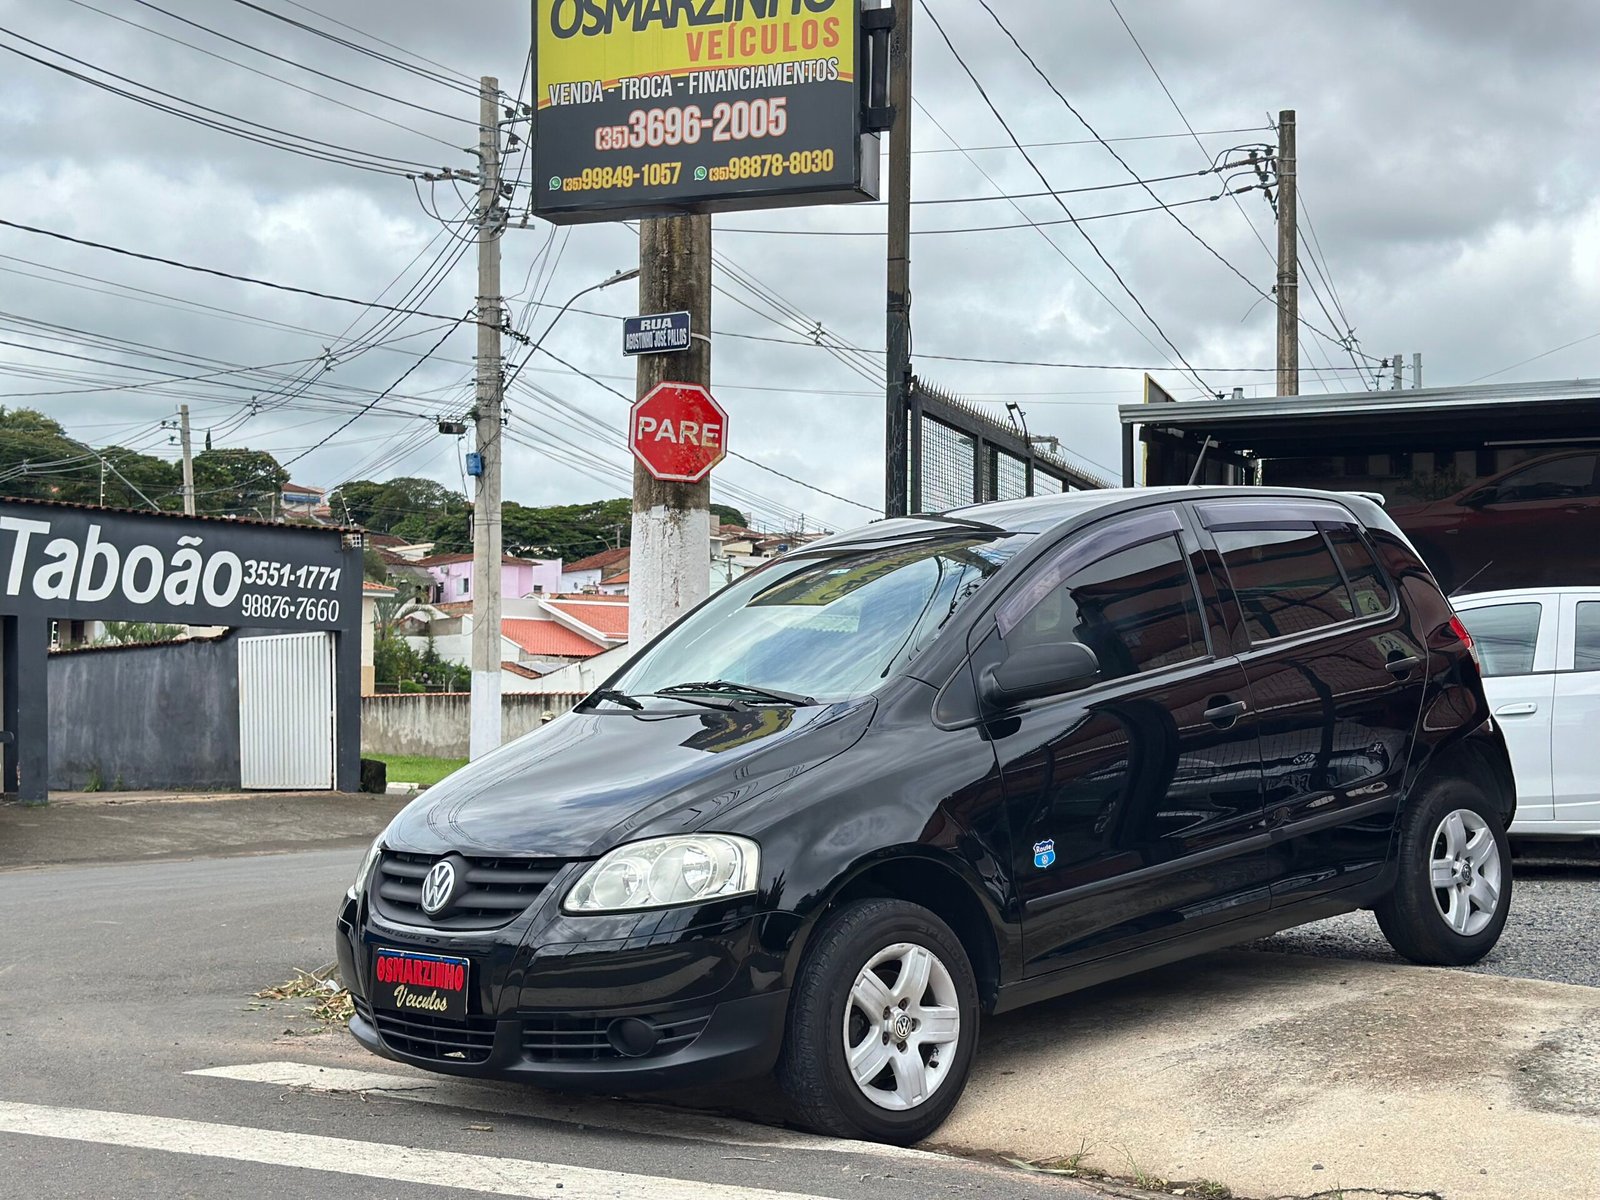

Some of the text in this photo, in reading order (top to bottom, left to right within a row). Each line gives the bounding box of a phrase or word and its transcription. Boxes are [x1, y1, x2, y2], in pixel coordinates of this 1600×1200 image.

[550, 0, 836, 39] OSMARZ
[685, 16, 841, 62] VEÍCULOS
[548, 80, 604, 107] VENDA
[618, 73, 673, 101] TROCA
[688, 57, 840, 95] FINANCIAMENTOS
[640, 317, 673, 331] RUA
[637, 416, 720, 448] PARE
[0, 515, 243, 608] Taboão
[377, 957, 464, 991] OSMARZINHO
